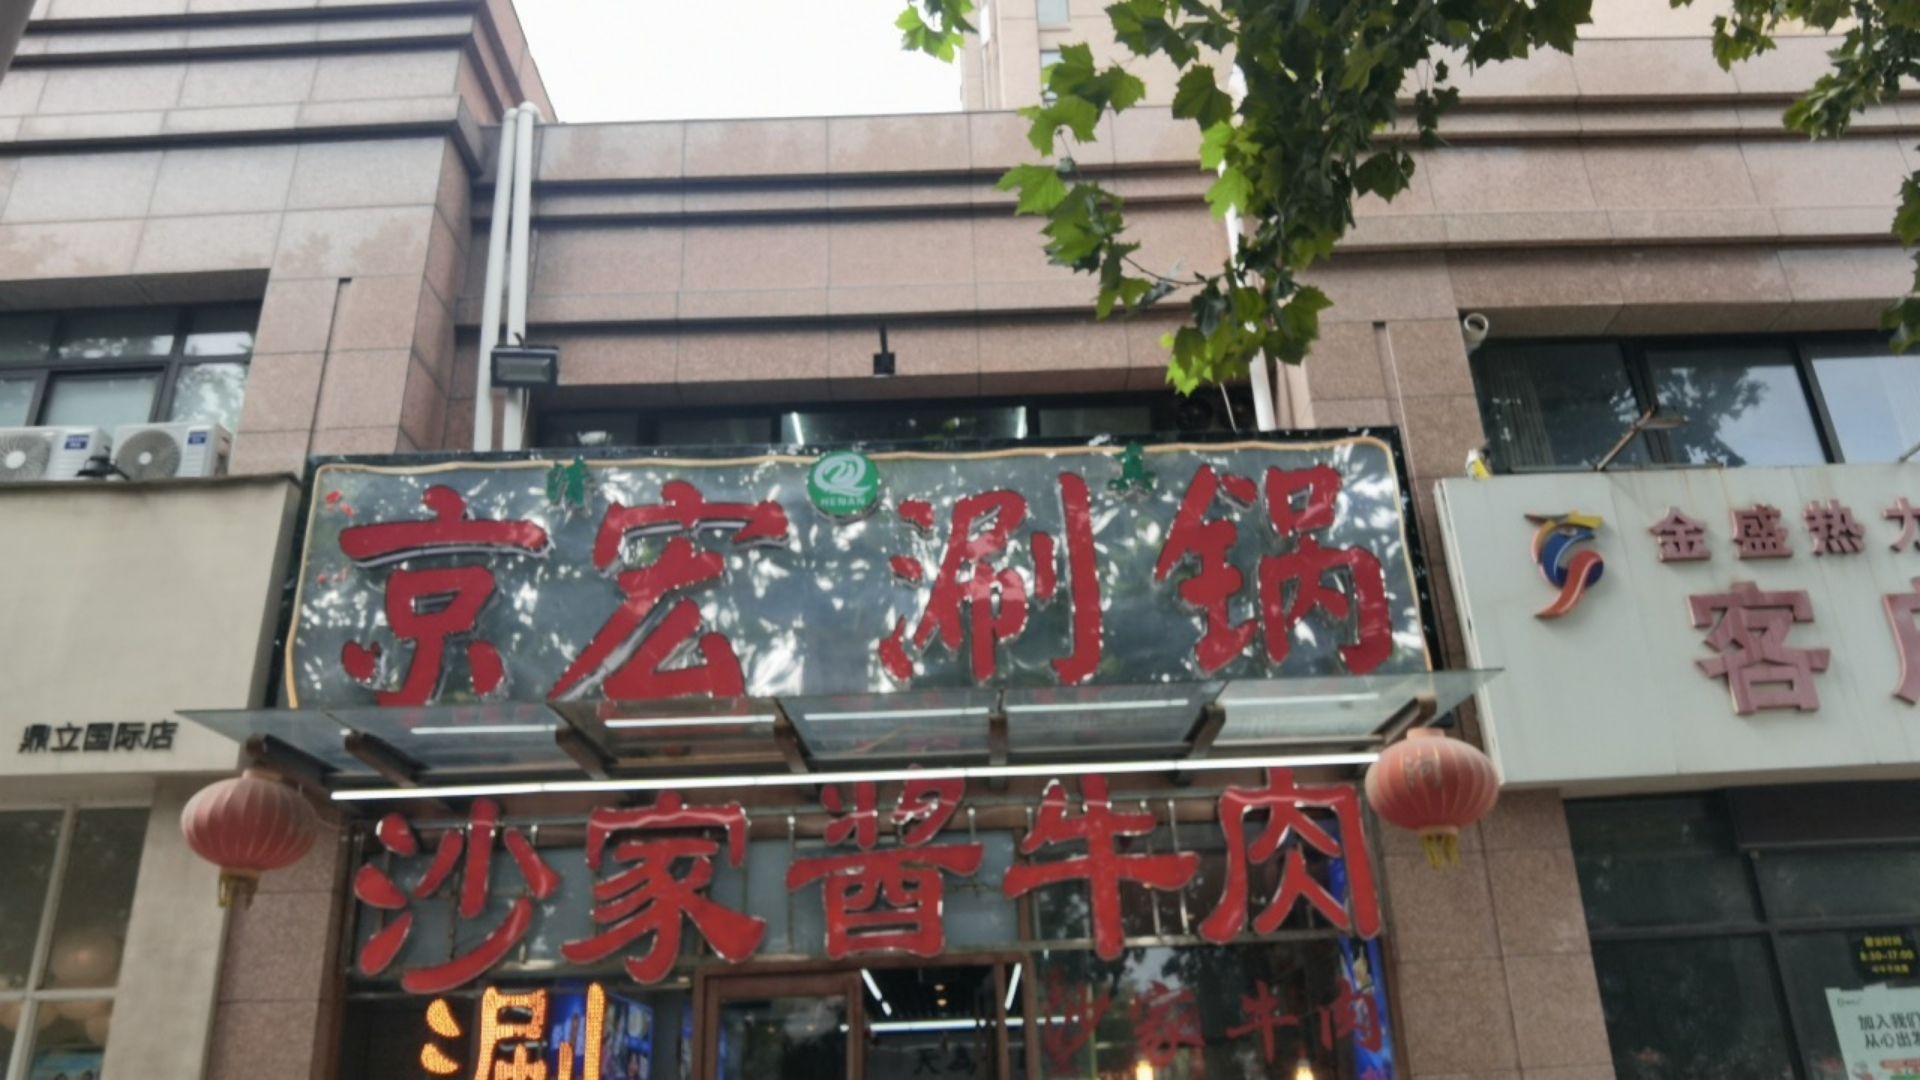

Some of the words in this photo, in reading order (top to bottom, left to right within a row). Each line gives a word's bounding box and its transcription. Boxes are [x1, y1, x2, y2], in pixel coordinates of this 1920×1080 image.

[338, 464, 1392, 708] 京宏涮锅
[18, 719, 178, 755] 鼎立国际店
[354, 764, 1382, 995] 沙家酱牛肉
[1857, 1011, 1920, 1031] 加入我们
